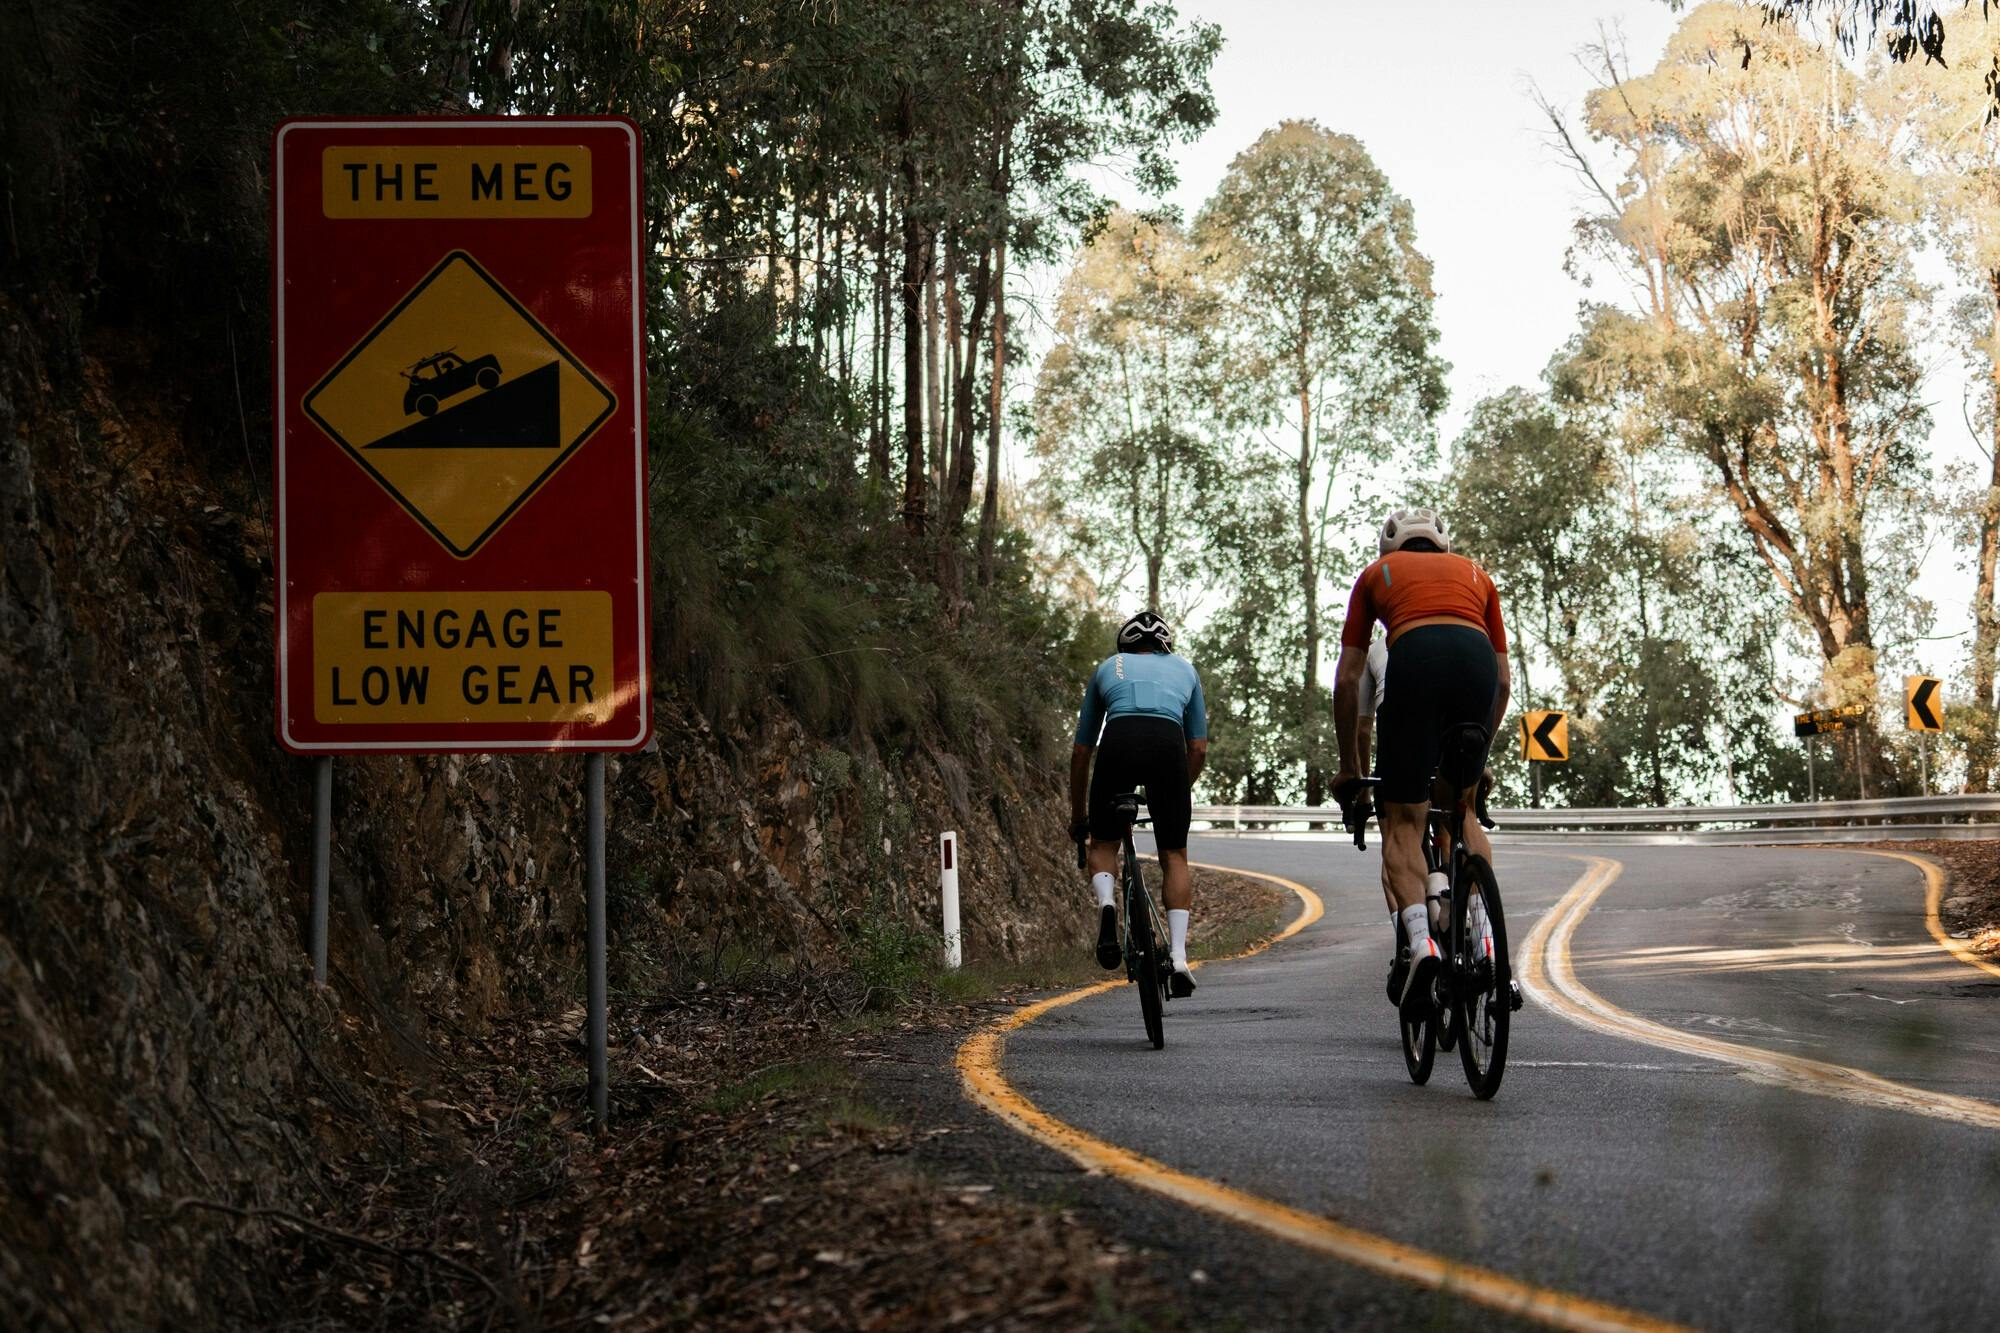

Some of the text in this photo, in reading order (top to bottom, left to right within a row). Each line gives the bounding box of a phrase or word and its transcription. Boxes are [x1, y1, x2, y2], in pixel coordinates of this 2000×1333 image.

[343, 162, 573, 201] THE MEG
[363, 608, 564, 650] ENGAGE
[331, 664, 595, 706] LOW GEAR
